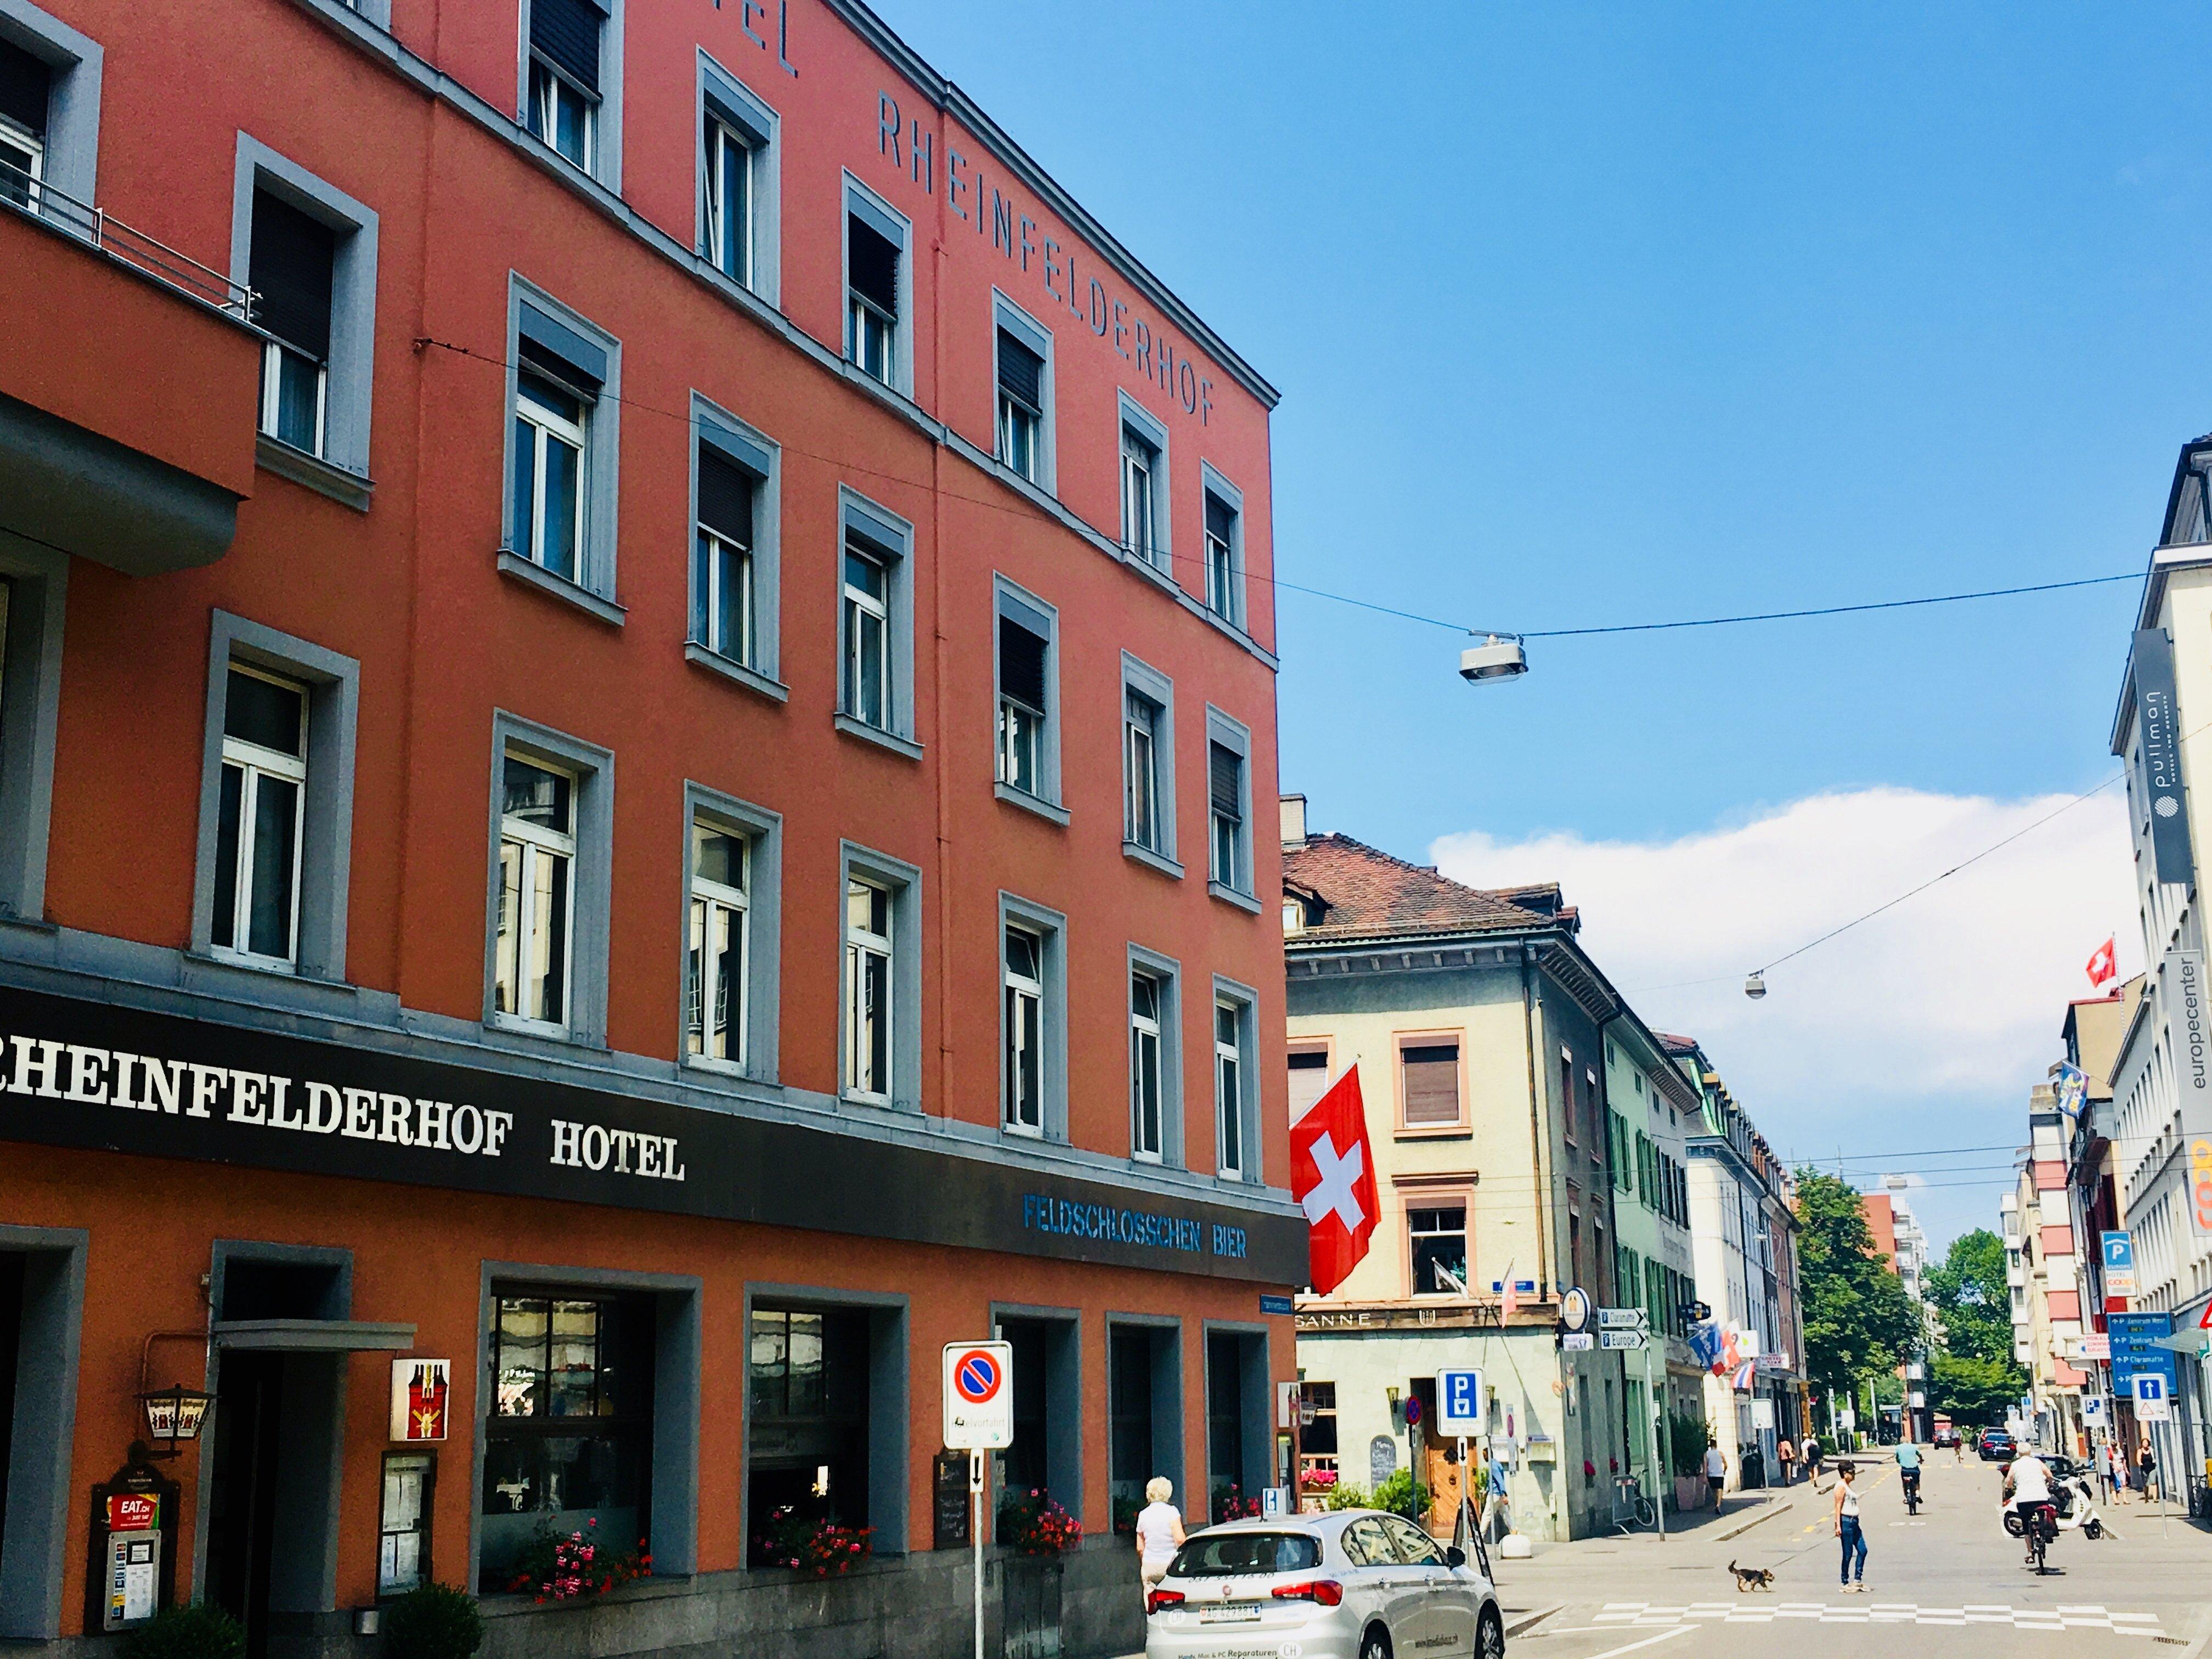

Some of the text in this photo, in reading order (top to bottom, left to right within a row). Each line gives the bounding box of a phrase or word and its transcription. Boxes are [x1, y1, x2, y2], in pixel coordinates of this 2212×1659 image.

[713, 0, 1213, 427] EL RHEINFELDERHOF
[2146, 691, 2171, 787] pullman
[2180, 957, 2206, 1088] europecenter
[550, 1118, 685, 1182] HOTEL
[1212, 1224, 1247, 1258] BIER
[2112, 1244, 2124, 1260] P
[1612, 1334, 1635, 1348] Europe
[1454, 1376, 1469, 1398] P
[1171, 1612, 1182, 1623] CH
[1228, 1649, 1277, 1658] Reparaturen
[1284, 1644, 1296, 1656] CH
